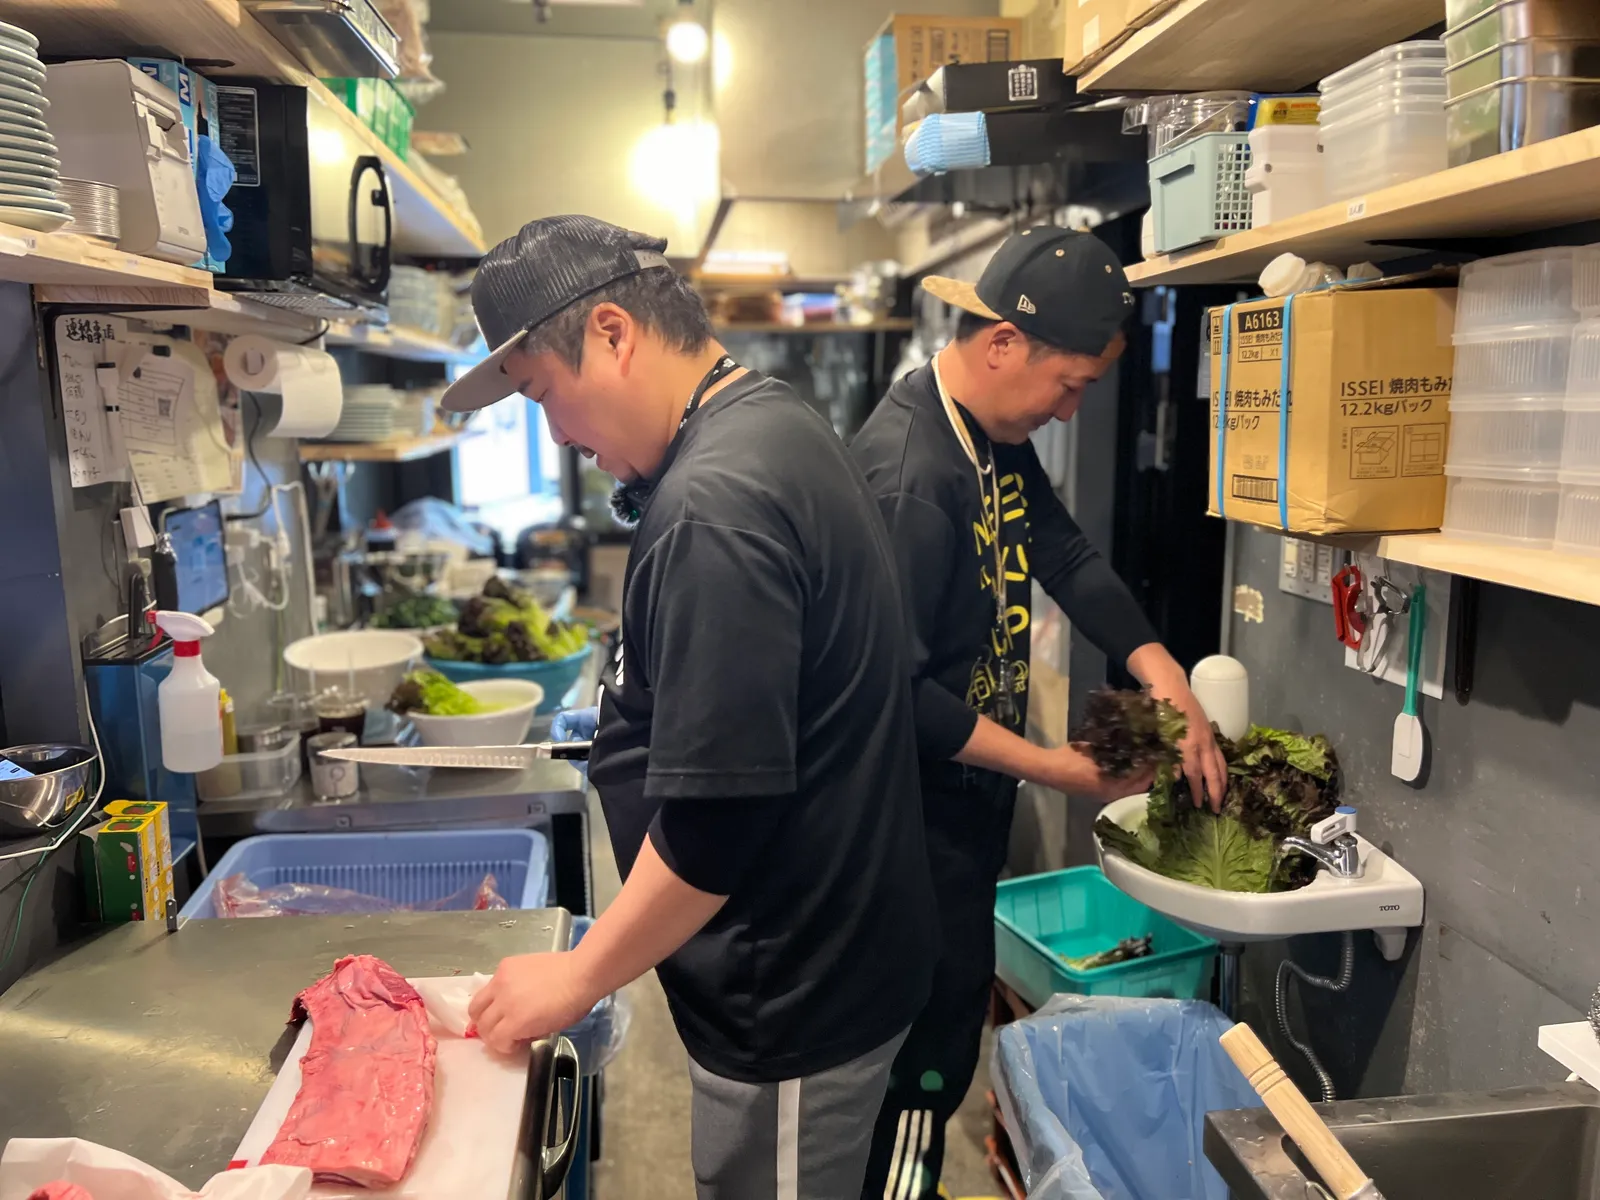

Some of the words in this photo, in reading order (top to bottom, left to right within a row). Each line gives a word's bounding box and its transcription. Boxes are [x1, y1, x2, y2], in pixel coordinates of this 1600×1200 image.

[1245, 310, 1280, 330] A6163
[65, 317, 115, 344] 連絡事項
[1341, 379, 1384, 397] ISSEI
[1389, 375, 1452, 395] 焼肉もみ
[1213, 390, 1232, 408] ISEI
[1379, 904, 1401, 912] TOTO
